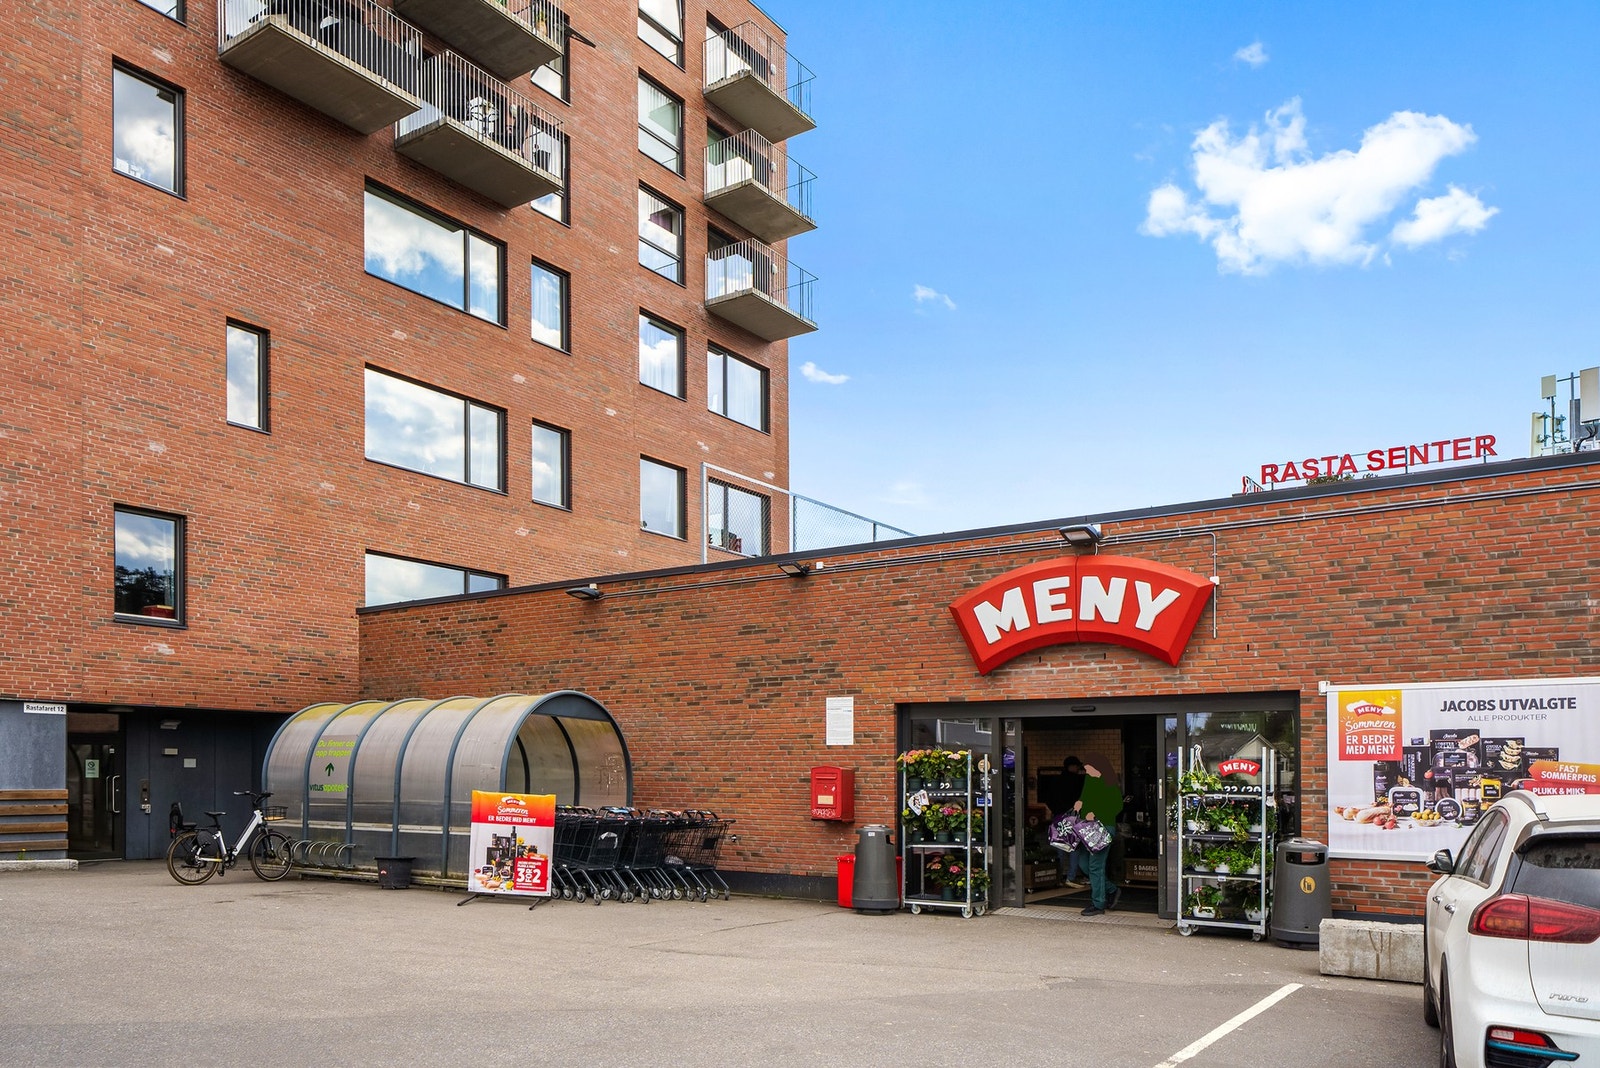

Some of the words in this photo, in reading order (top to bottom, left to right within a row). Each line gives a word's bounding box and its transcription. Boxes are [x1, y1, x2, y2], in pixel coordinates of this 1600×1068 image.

[1261, 453, 1358, 485] RASTA
[1367, 434, 1498, 471] SENTER
[973, 576, 1181, 645] MENY
[25, 704, 56, 712] Rastafaret
[1357, 706, 1382, 714] MENY
[1440, 699, 1496, 712] JACOBS
[1499, 697, 1577, 711] UTVALGTE
[1467, 714, 1489, 722] ALLE
[1492, 713, 1548, 722] PRODUKTER
[1345, 720, 1397, 732] Sommeren
[1346, 735, 1359, 745] ER
[1362, 734, 1395, 745] BEDRE
[1346, 745, 1366, 755] MED
[1368, 745, 1395, 755] MENY
[1222, 762, 1256, 773] MENY
[1559, 764, 1580, 774] FAST
[1541, 771, 1597, 783] SOMMERPRIS
[1532, 787, 1558, 795] PLUKK
[1566, 787, 1586, 795] MIKS
[516, 868, 525, 883] 3
[525, 869, 533, 883] FOR
[533, 869, 541, 883] 2
